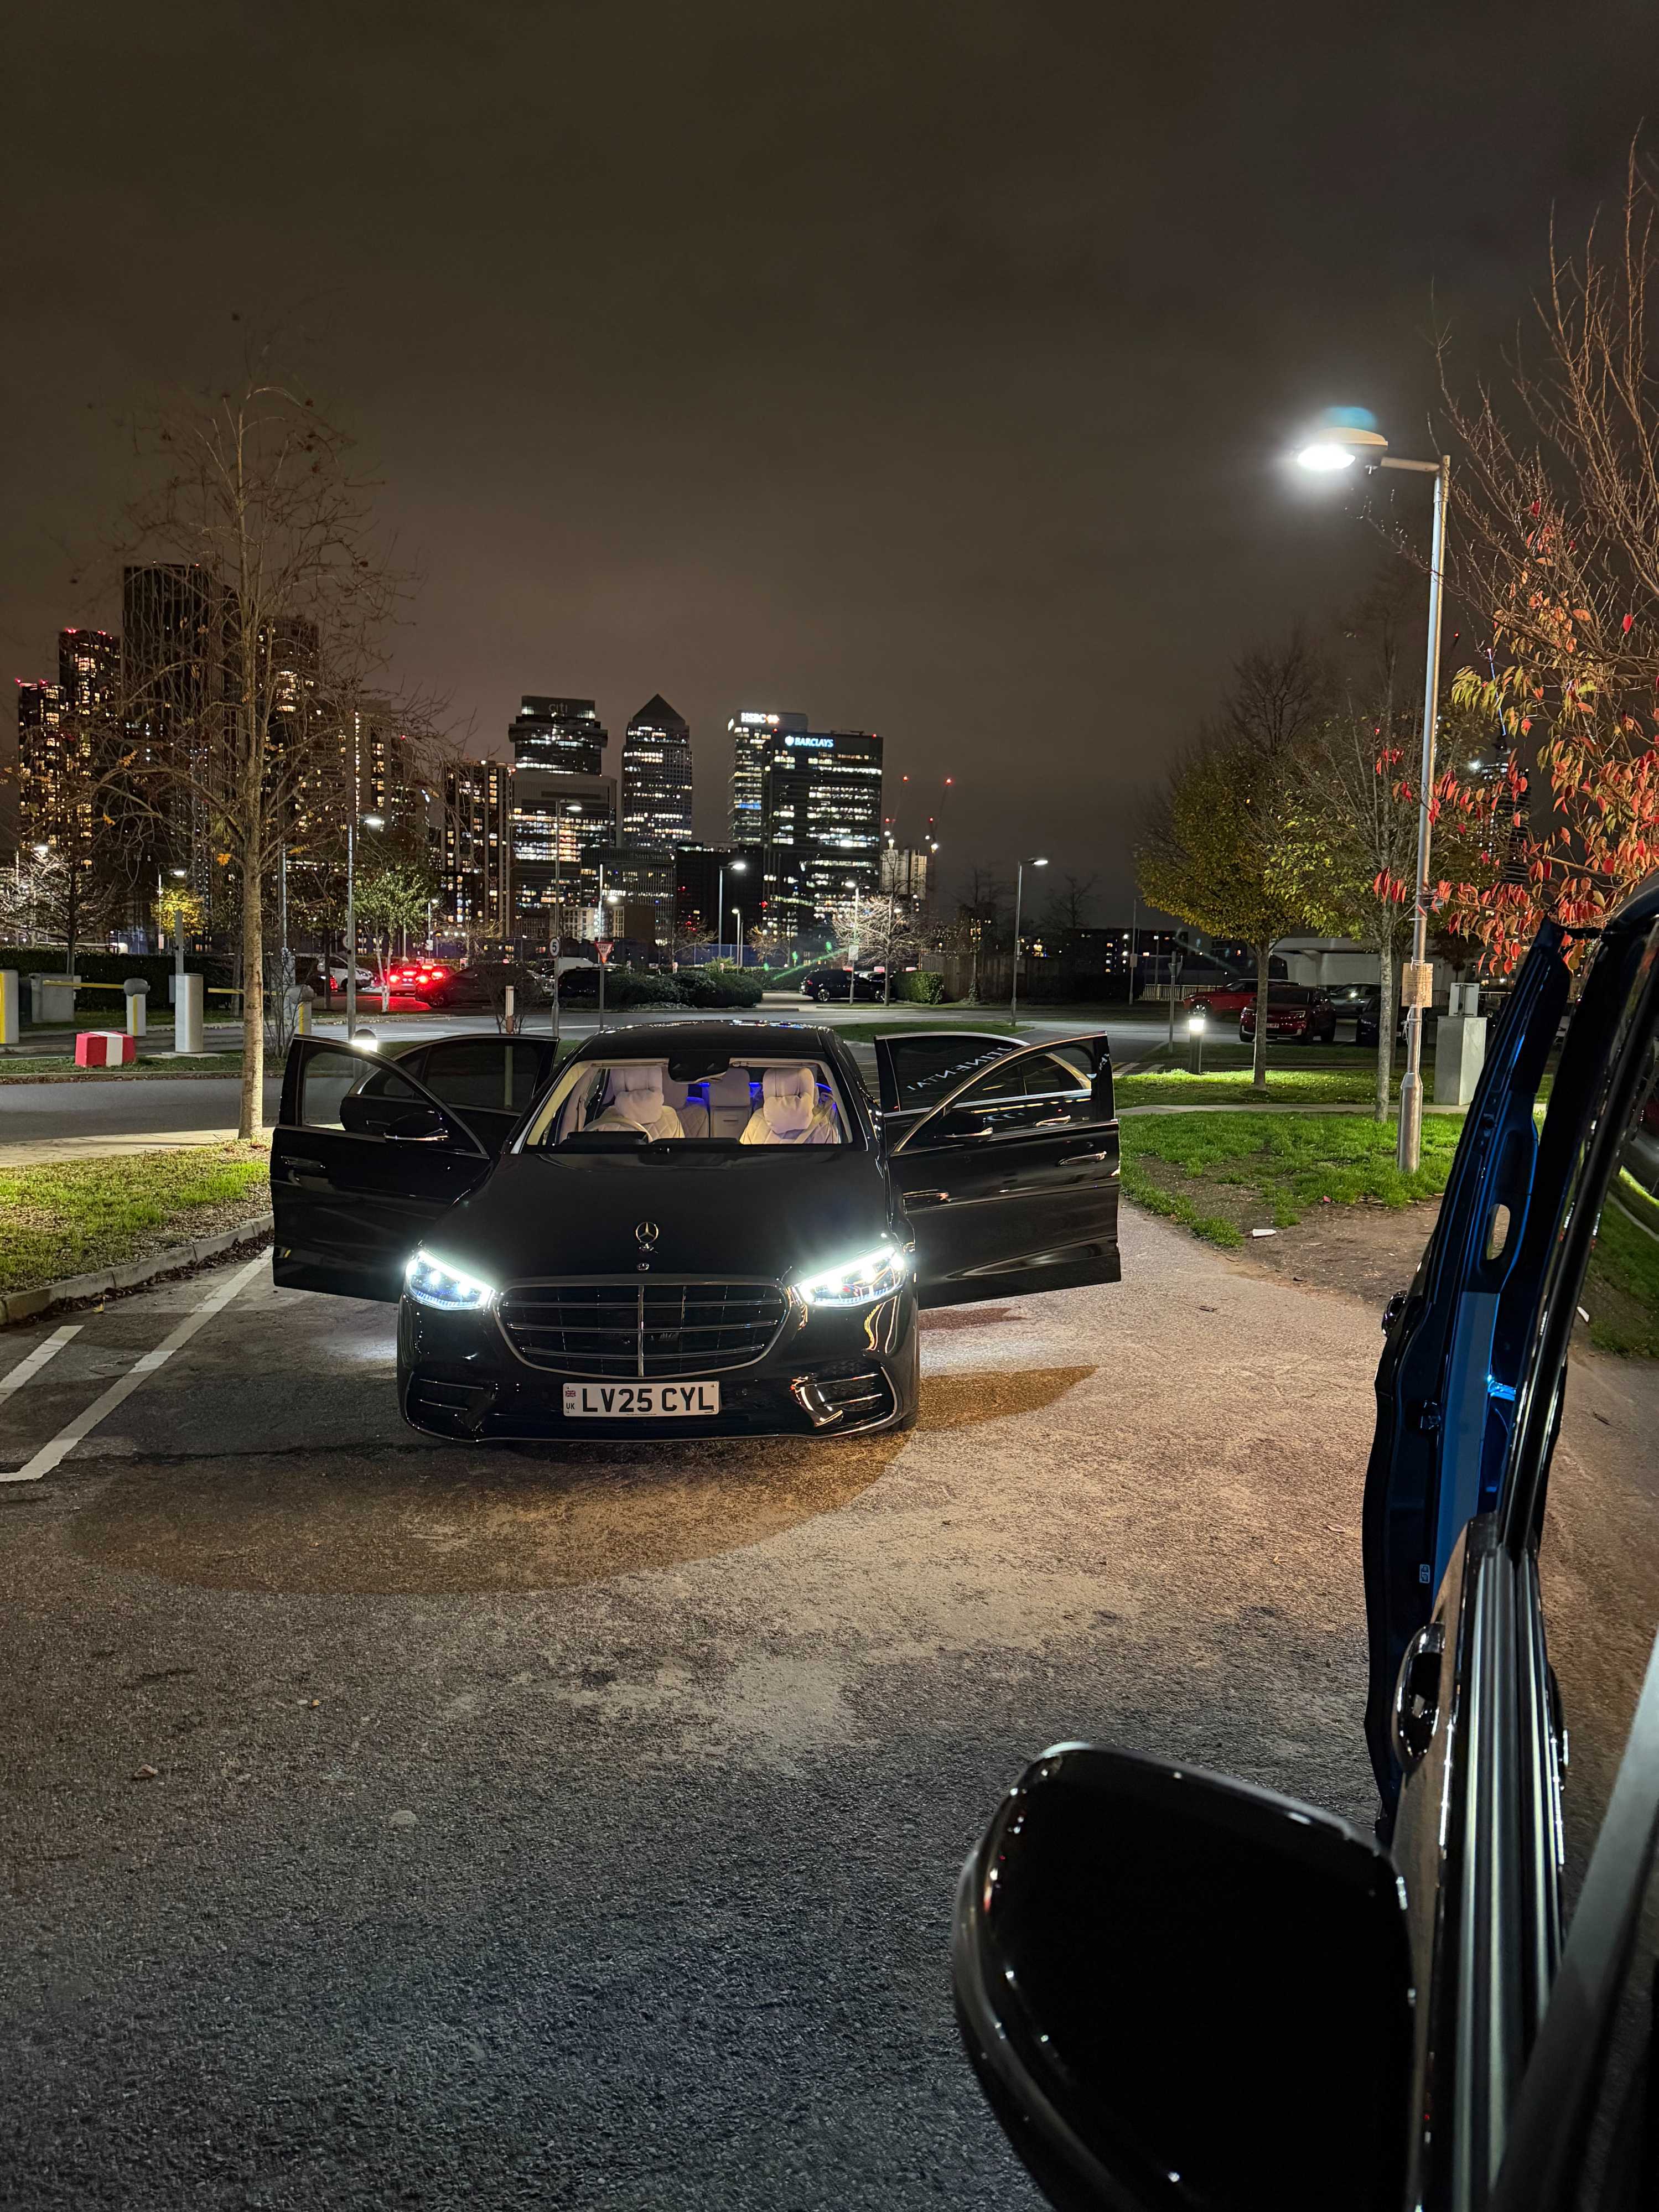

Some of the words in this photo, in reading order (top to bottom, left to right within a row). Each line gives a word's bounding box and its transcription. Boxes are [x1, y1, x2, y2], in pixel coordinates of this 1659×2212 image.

[794, 737, 834, 748] BARCLAYS
[552, 942, 557, 953] 5
[582, 1388, 652, 1413] LV25
[661, 1387, 714, 1411] CYL
